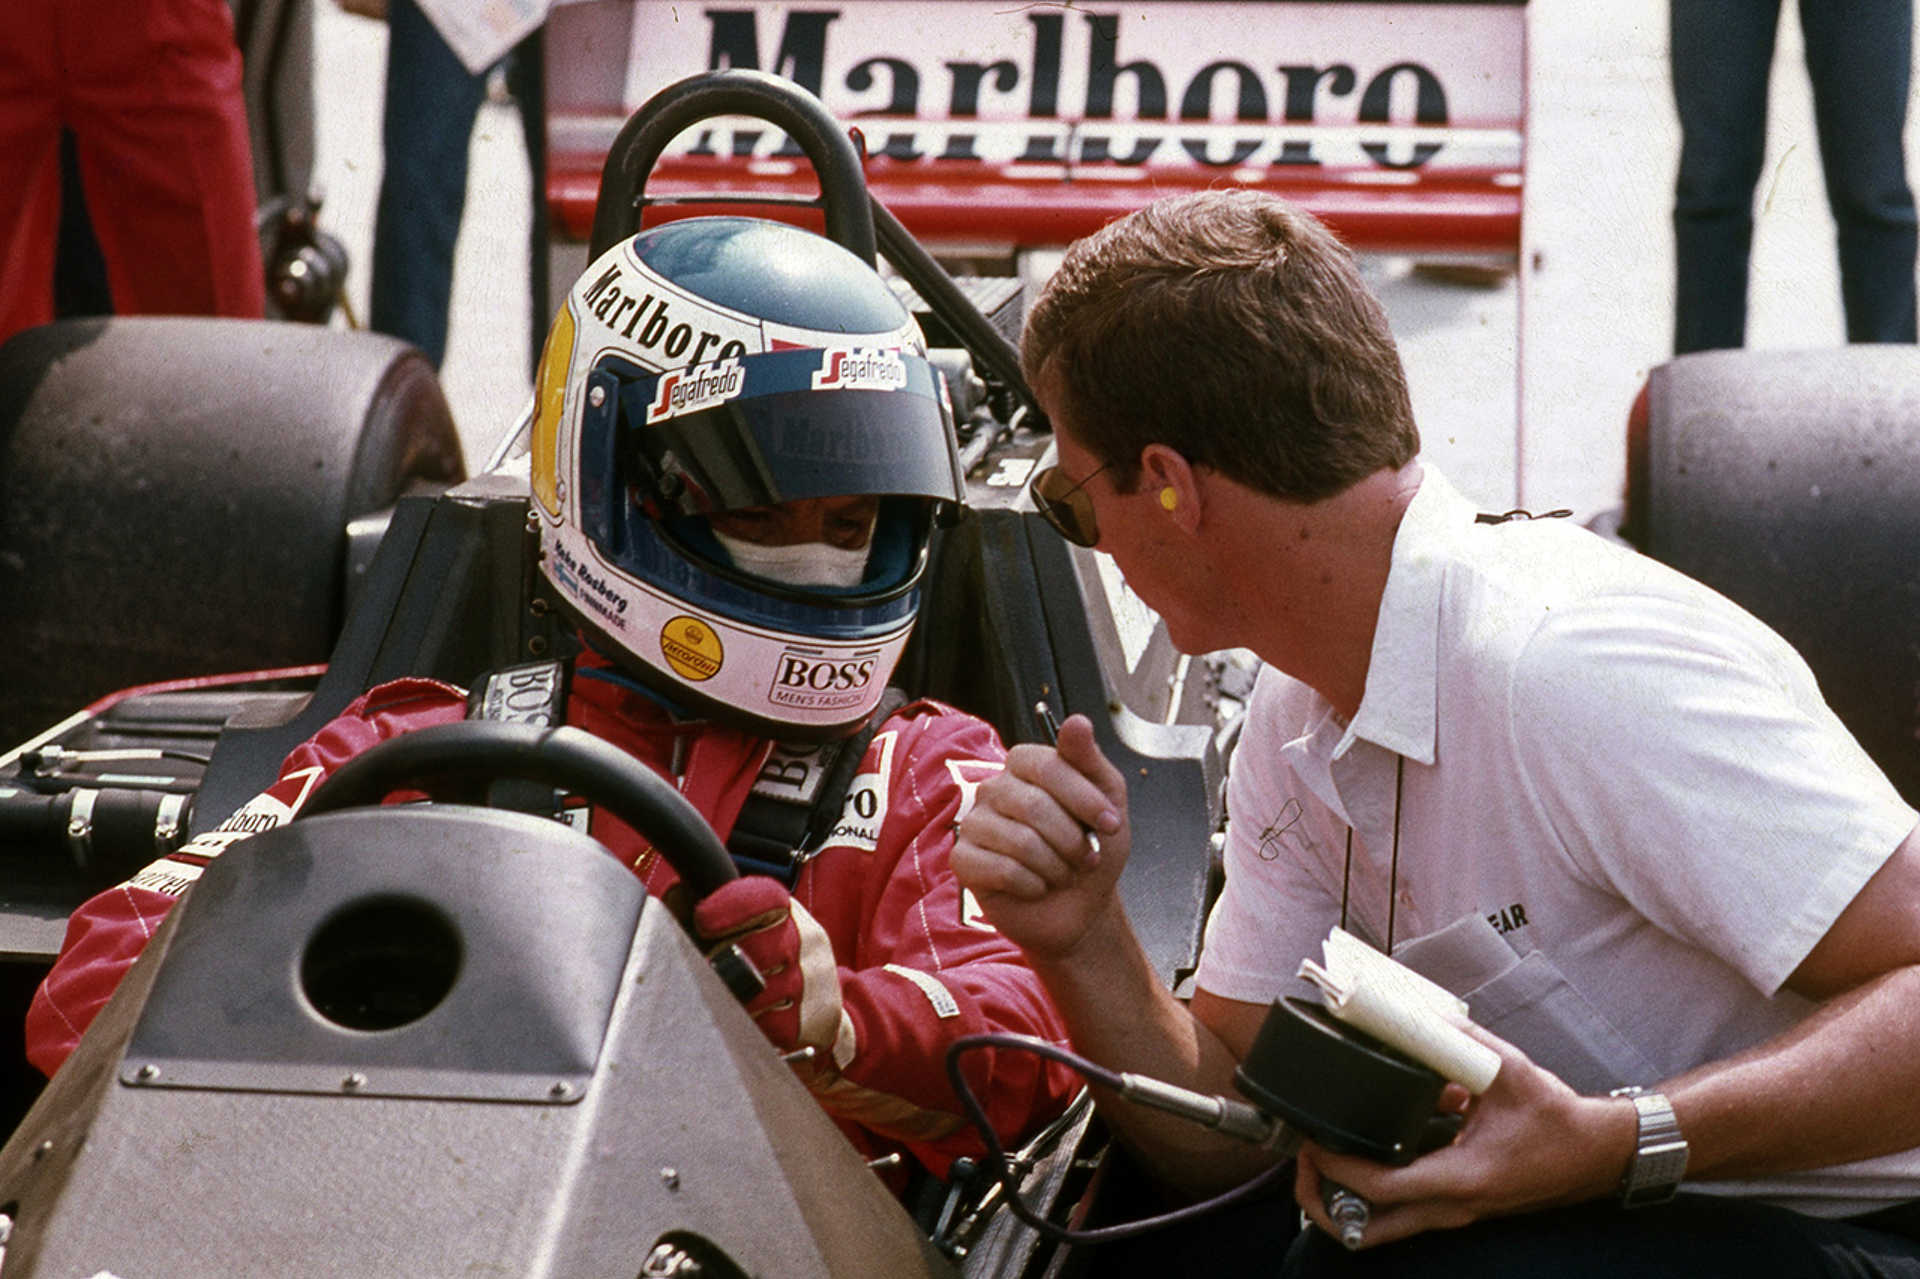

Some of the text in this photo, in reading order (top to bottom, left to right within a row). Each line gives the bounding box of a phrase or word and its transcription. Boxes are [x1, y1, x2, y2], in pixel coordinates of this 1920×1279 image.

[688, 9, 1448, 169] Marlboro
[582, 262, 747, 376] Marlboro
[652, 365, 738, 417] Segafredo
[820, 351, 901, 385] Segafredo
[779, 657, 874, 691] BOSS
